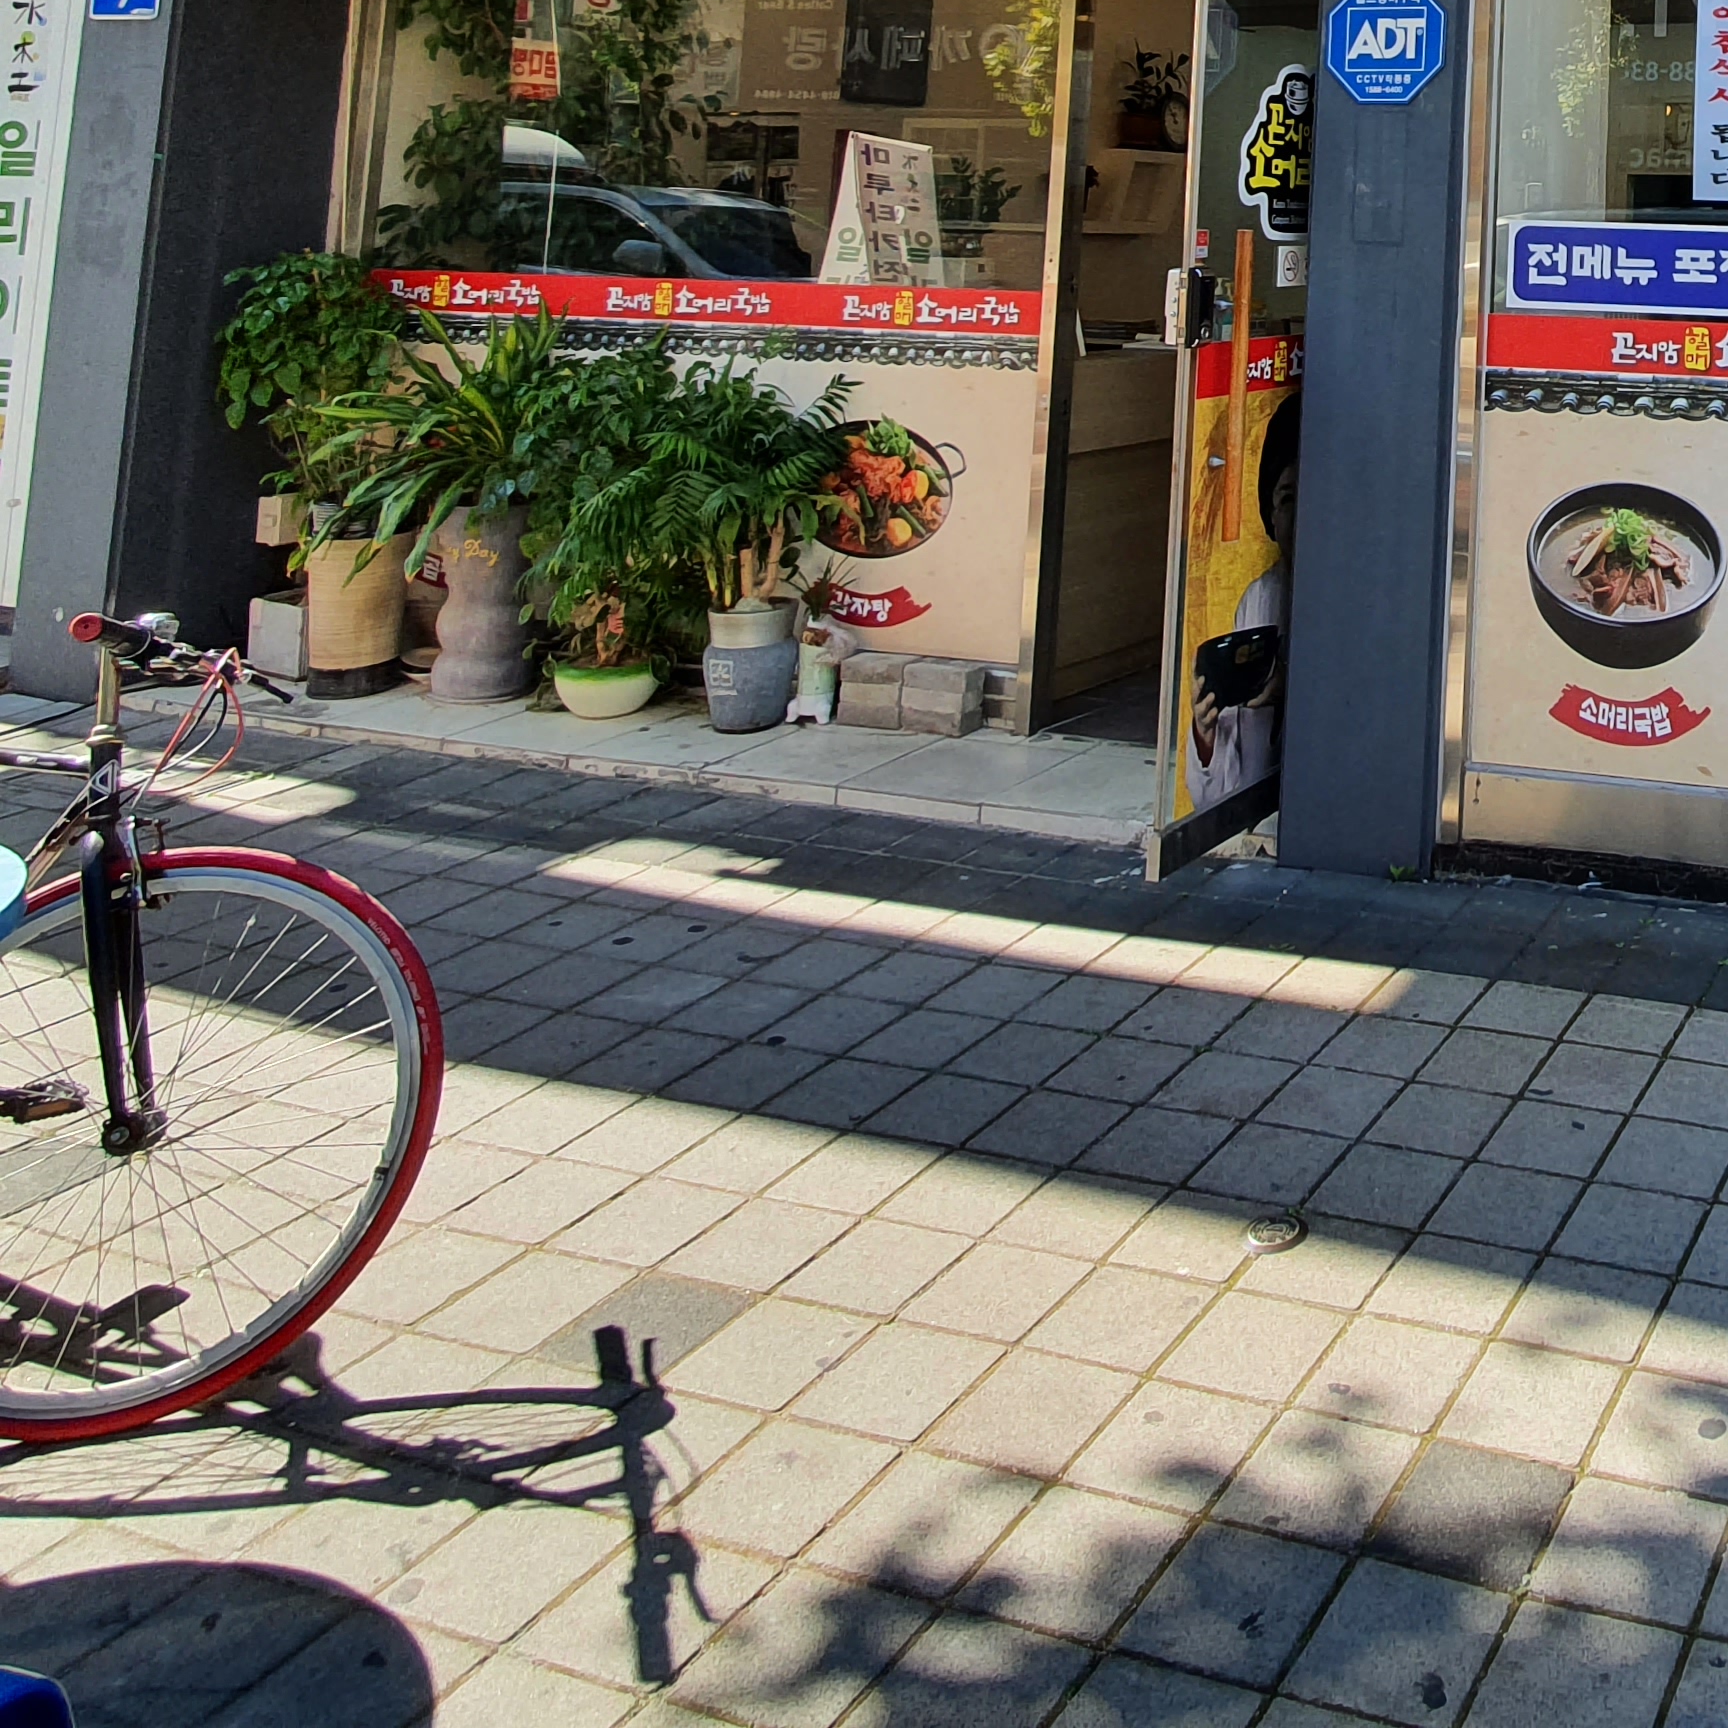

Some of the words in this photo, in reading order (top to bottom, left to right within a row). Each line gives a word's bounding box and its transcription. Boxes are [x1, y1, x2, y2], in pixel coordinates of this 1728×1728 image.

[1347, 17, 1427, 60] ADT
[1526, 241, 1660, 287] 전메뉴
[675, 285, 772, 316] 소머리국밥
[917, 296, 1020, 326] 소머리국밥
[1610, 330, 1682, 365] 곤지암
[1577, 696, 1673, 738] 소머리국밥
